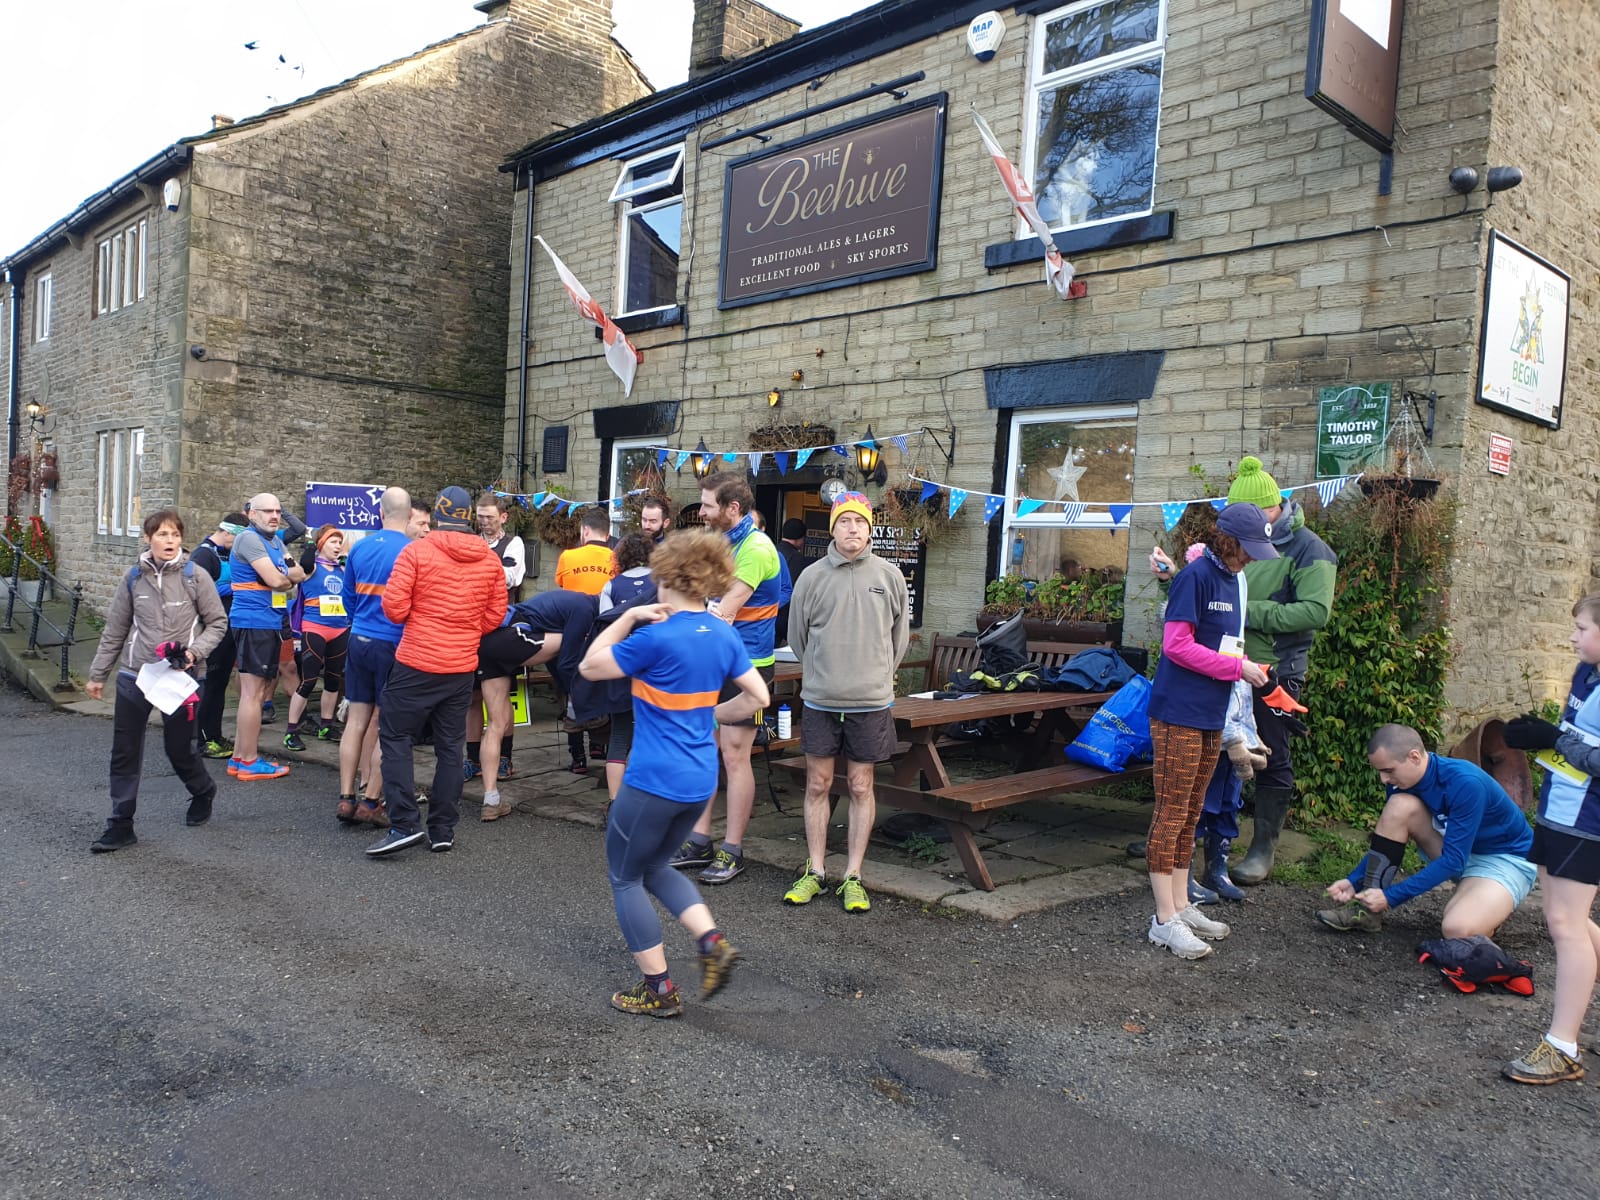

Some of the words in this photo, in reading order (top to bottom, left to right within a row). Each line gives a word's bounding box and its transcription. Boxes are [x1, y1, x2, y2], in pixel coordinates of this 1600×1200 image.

[972, 20, 993, 34] MAP
[814, 148, 840, 171] THE
[746, 142, 908, 234] Beehive
[752, 246, 814, 267] TRADITIONAL
[816, 238, 841, 252] ALES
[844, 236, 852, 246] &
[856, 225, 896, 244] LAGERS
[740, 268, 791, 287] EXCELLENT
[794, 262, 820, 276] FOOD
[847, 252, 866, 264] SKY
[868, 242, 909, 260] SPORTS
[1512, 360, 1539, 390] BEGIN
[1326, 420, 1378, 432] TIMOTHY
[1330, 434, 1372, 445] TAYLOR
[311, 496, 359, 512] mummys
